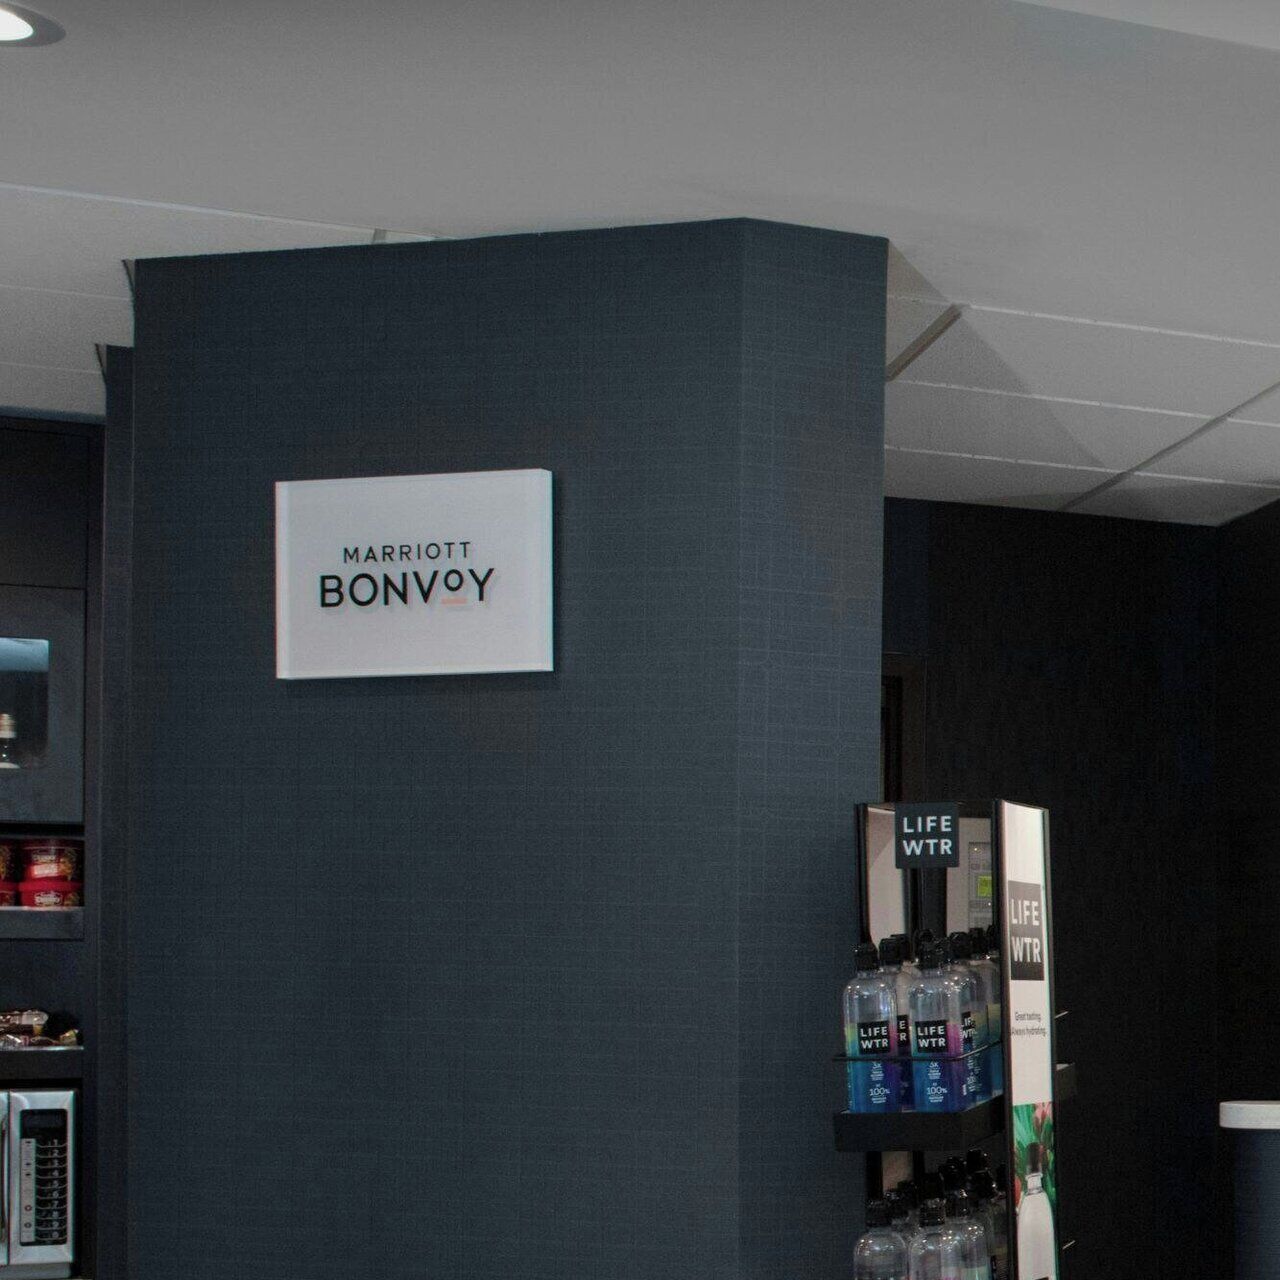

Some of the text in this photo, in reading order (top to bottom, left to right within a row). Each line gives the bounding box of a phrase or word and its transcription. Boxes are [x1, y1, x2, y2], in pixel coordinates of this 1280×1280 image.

[343, 541, 471, 564] MARRIOTT
[320, 567, 495, 608] BONVOY
[903, 815, 952, 833] LIFE
[902, 838, 953, 856] WTR
[1010, 898, 1040, 926] LIFE
[1011, 936, 1041, 963] WTR
[860, 1026, 888, 1037] LIFE
[917, 1025, 945, 1036] LIFE
[860, 1038, 889, 1049] WTR
[918, 1037, 946, 1047] WTR
[869, 1087, 890, 1096] 100%
[926, 1086, 948, 1095] 100%
